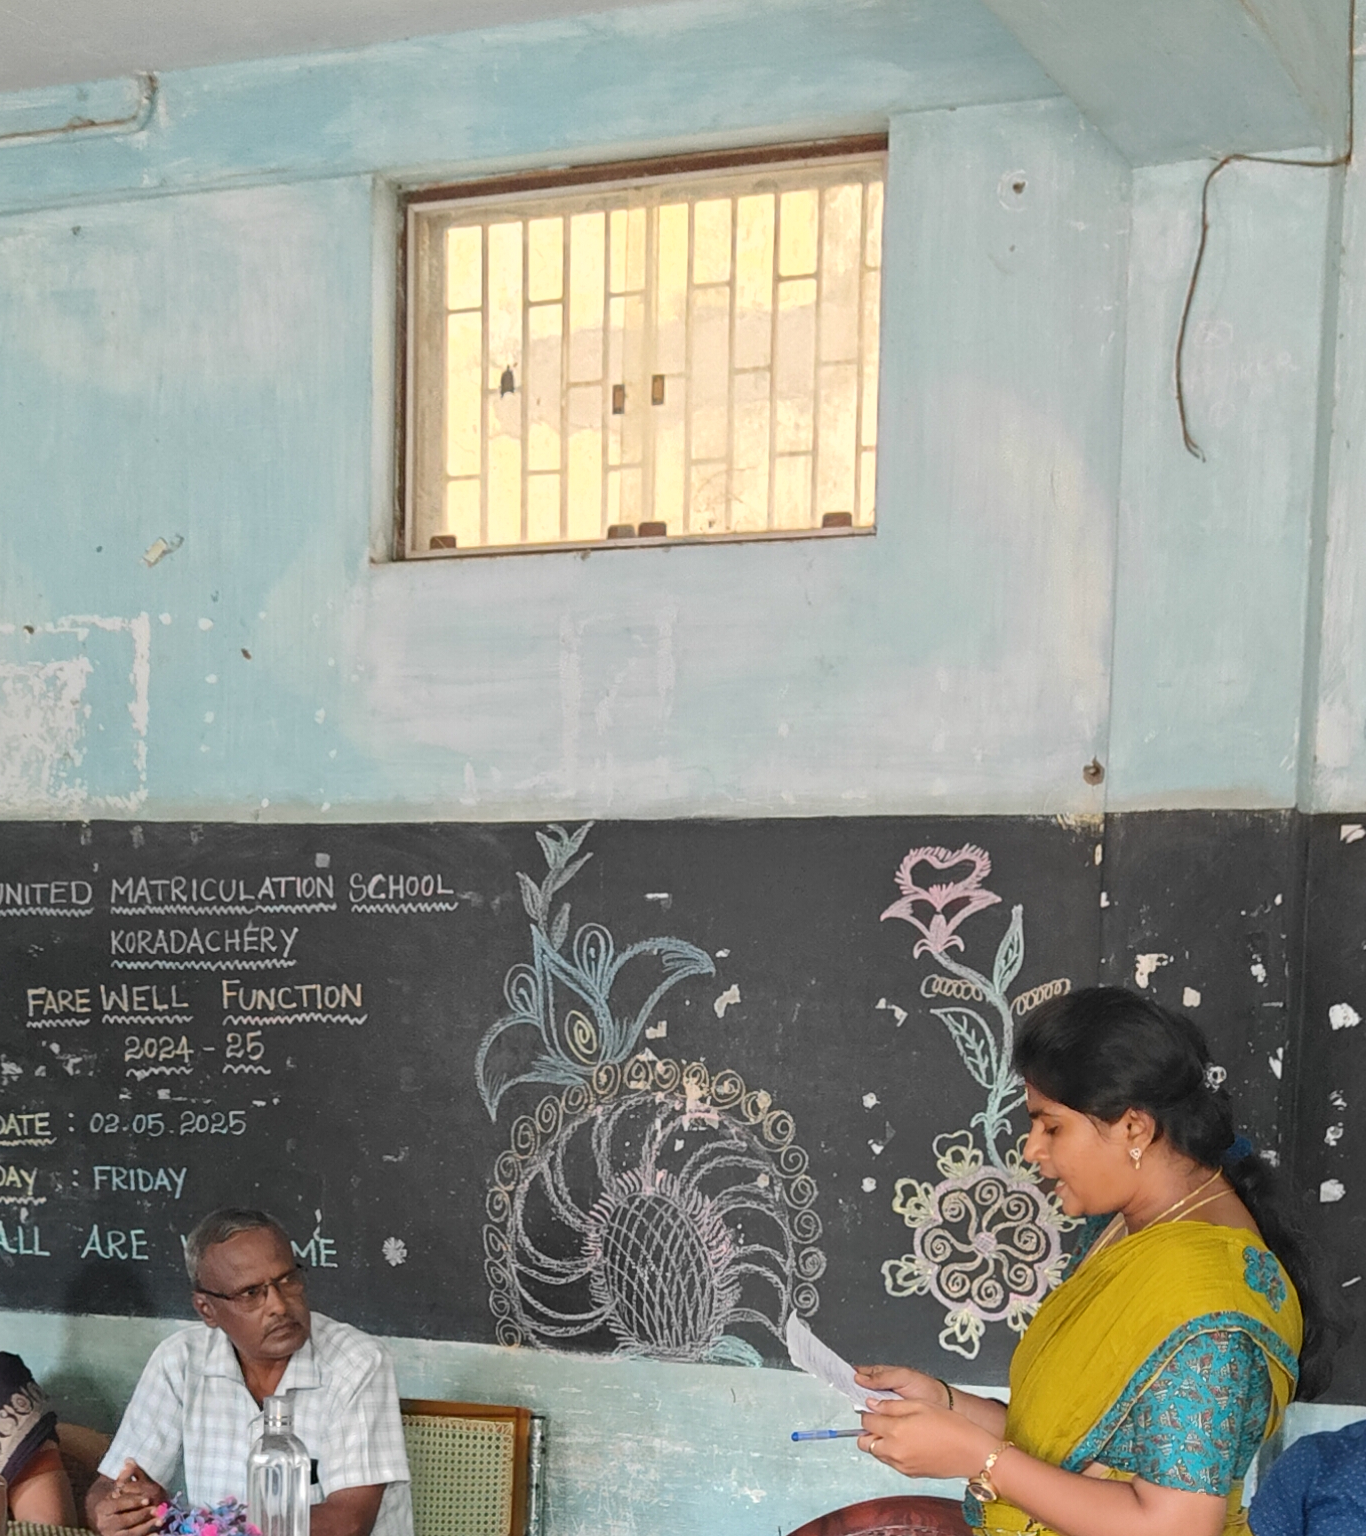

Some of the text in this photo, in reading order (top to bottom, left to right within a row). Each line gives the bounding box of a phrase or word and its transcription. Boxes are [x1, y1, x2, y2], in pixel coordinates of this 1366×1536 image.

[110, 875, 335, 904] MATRICULATION
[349, 873, 455, 902] SCHOOL
[109, 925, 299, 956] KORADACHERY
[222, 979, 363, 1011] FUNCTION
[125, 1034, 194, 1062] 2024
[225, 1030, 265, 1061] 25
[88, 1110, 247, 1136] 02.05.2025
[93, 1165, 188, 1199] FRIDAY
[81, 1223, 149, 1260] ARE
